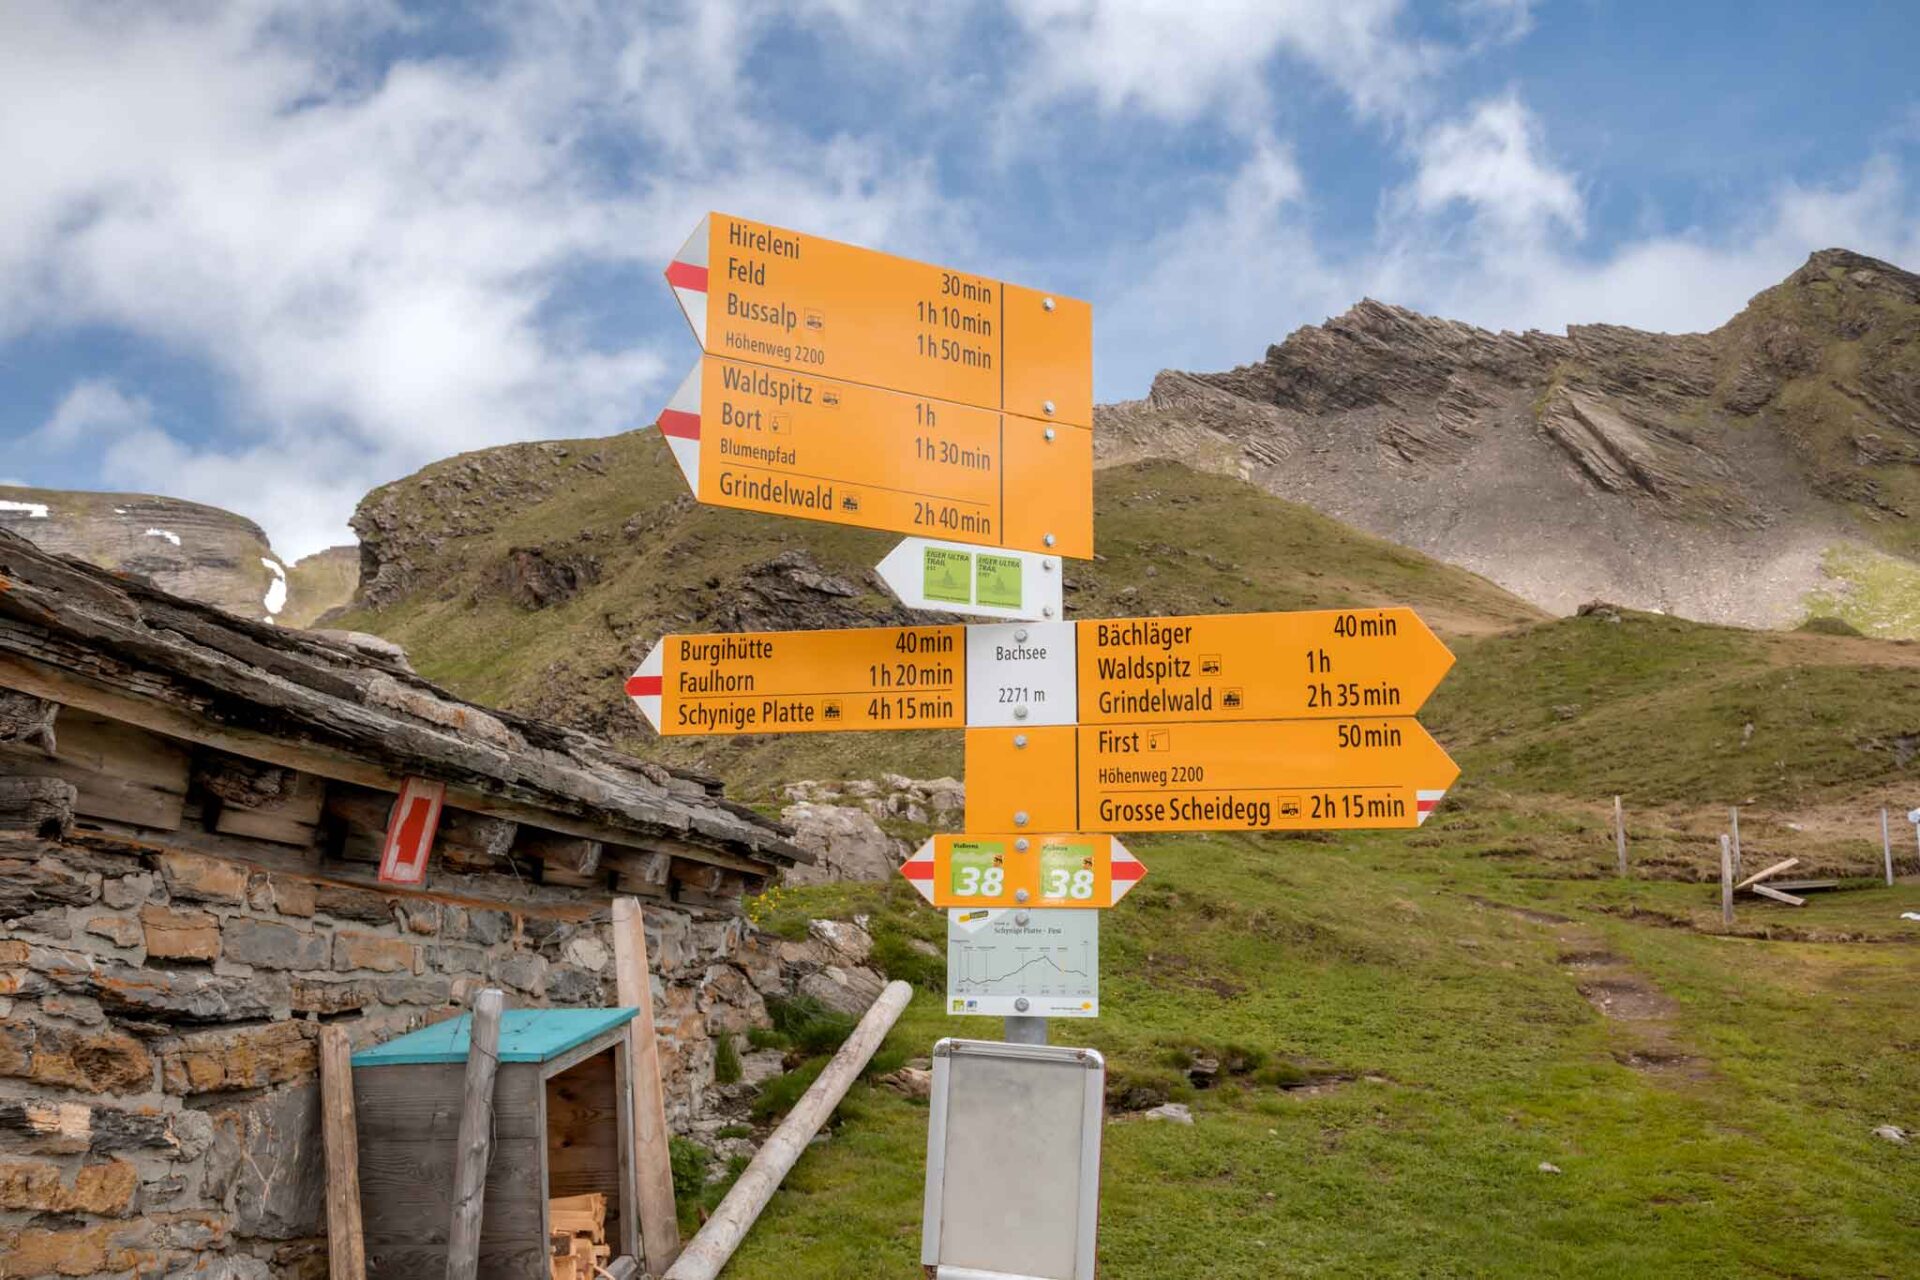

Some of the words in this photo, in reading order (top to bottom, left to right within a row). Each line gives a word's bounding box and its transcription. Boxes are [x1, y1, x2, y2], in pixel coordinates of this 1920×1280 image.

[729, 223, 800, 260] Hireleni
[728, 257, 766, 286] Feld
[727, 293, 797, 333] Bussalp
[726, 331, 791, 363] Höhenweg
[795, 346, 825, 365] 2200
[723, 366, 813, 406] Waldspitz
[722, 402, 761, 431] Bort
[720, 439, 796, 465] Blumenpfad
[720, 472, 832, 511] Grindelwald
[927, 558, 945, 566] TRAIL
[947, 554, 969, 562] ULTRA
[978, 557, 997, 565] EIGER
[999, 560, 1020, 568] ULTRA
[979, 564, 996, 573] TRAIL
[1098, 623, 1192, 650] Bächläger
[680, 638, 773, 665] Burgihütte
[996, 643, 1047, 661] Bachsee
[680, 671, 754, 692] Faulhorn
[1098, 655, 1191, 683] Waldspitz
[998, 686, 1027, 703] 2271
[1034, 690, 1045, 701] m
[1100, 687, 1212, 713] Grindelwald
[679, 702, 755, 730] Schynige
[763, 700, 814, 721] Platte
[1099, 729, 1140, 753] First
[1099, 766, 1167, 786] Höhenweg
[1172, 766, 1203, 782] 2200
[1100, 798, 1164, 821] Grosse
[1170, 796, 1270, 825] Scheidegg
[955, 867, 1004, 896] 38
[1045, 869, 1094, 898] 38
